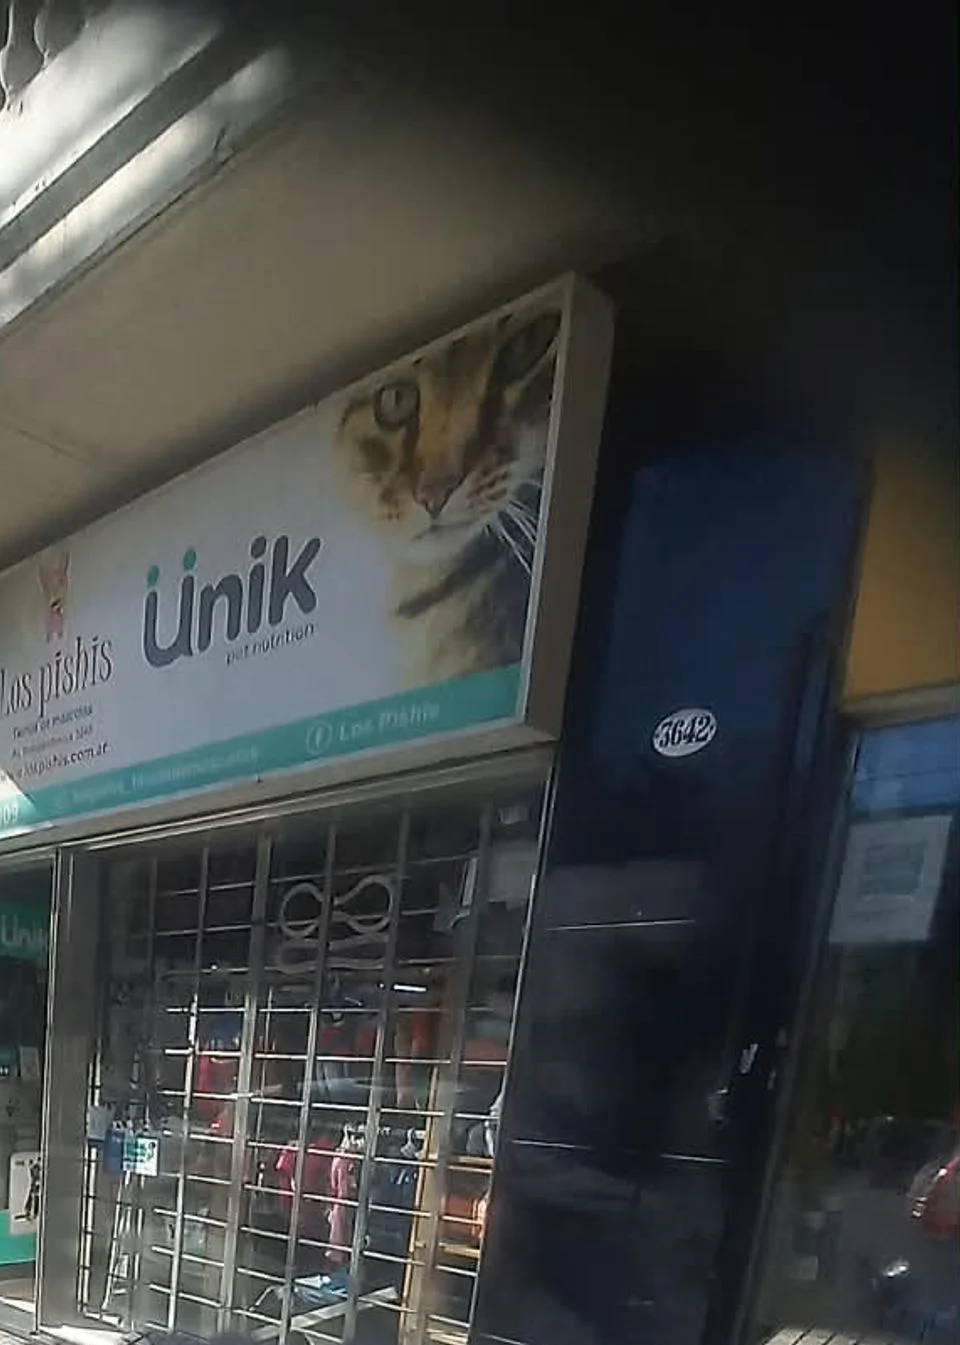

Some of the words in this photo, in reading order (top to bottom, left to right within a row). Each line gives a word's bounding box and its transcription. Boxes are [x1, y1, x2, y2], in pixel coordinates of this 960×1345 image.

[252, 623, 315, 655] nutrition
[0, 667, 32, 717] Los
[39, 634, 113, 718] pishis
